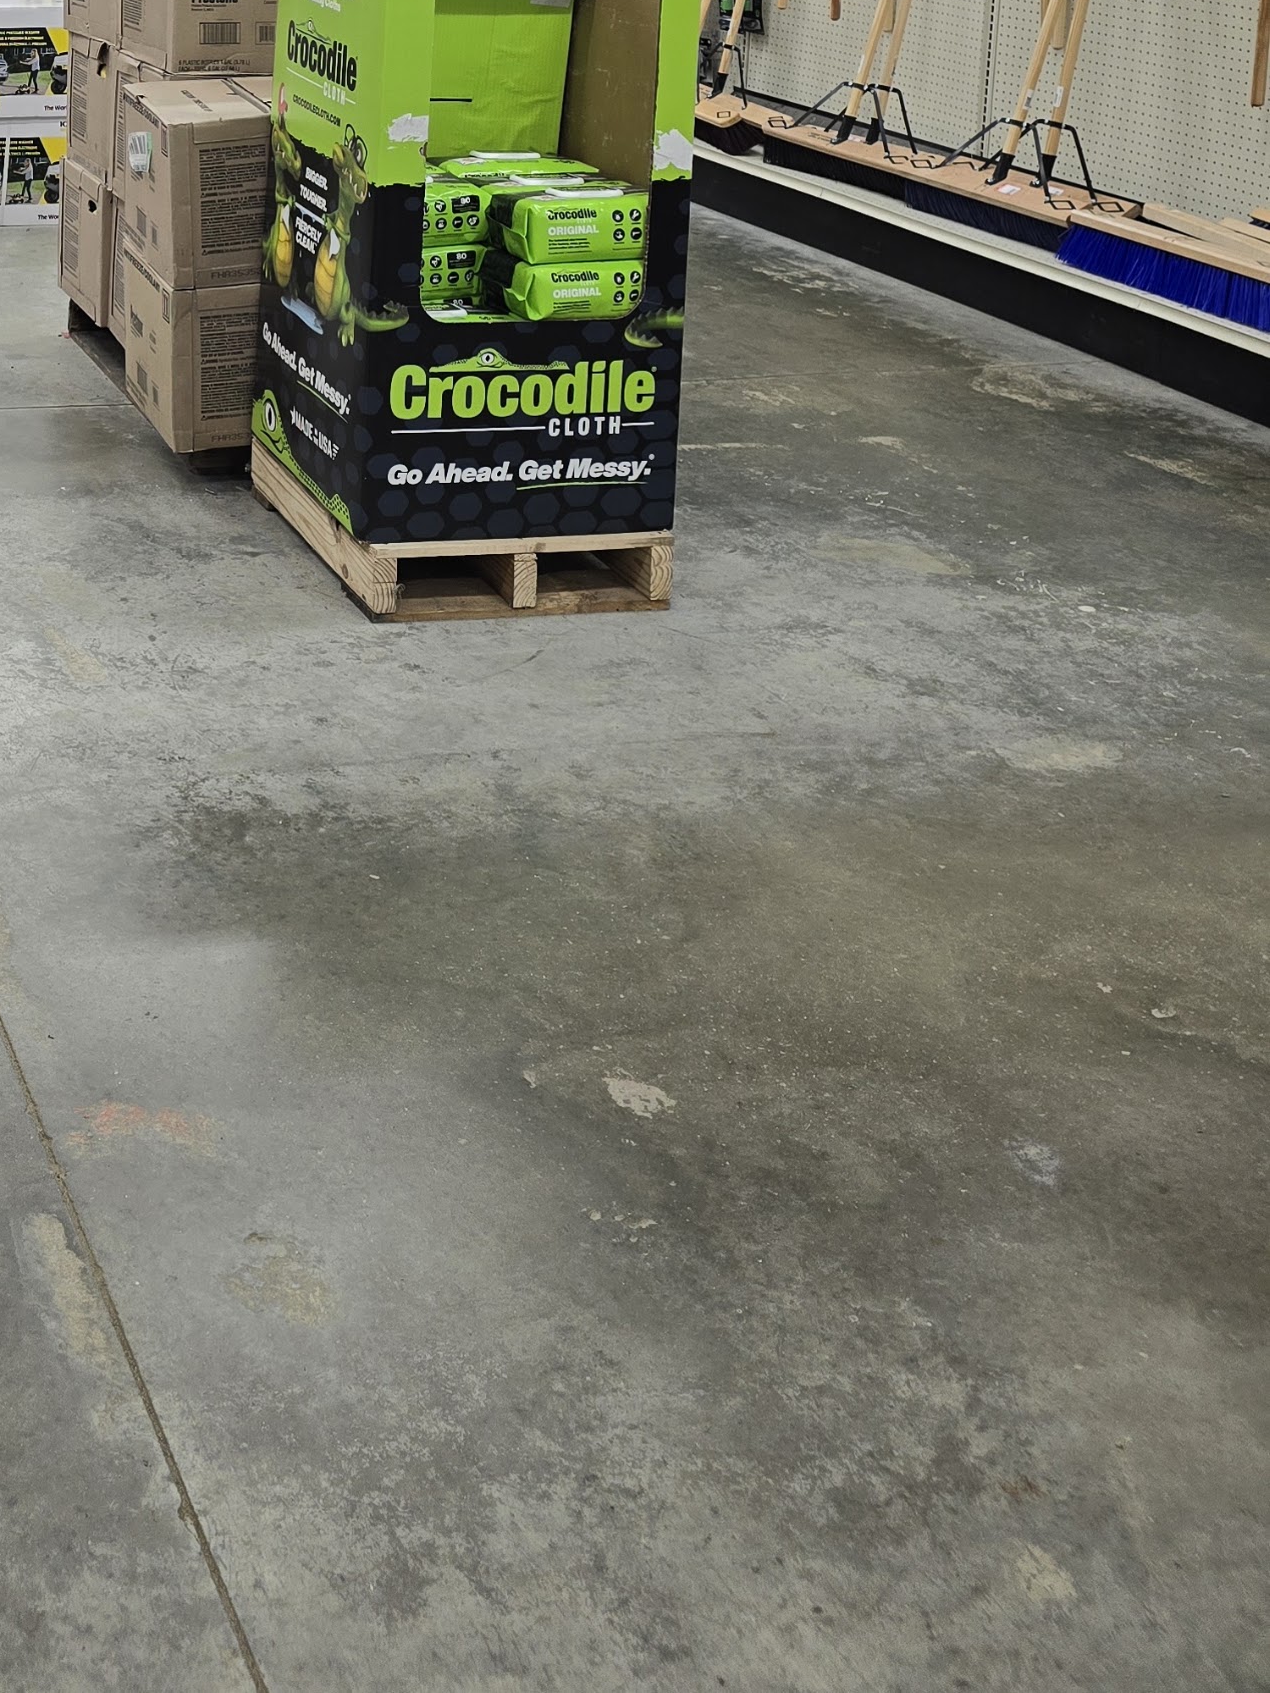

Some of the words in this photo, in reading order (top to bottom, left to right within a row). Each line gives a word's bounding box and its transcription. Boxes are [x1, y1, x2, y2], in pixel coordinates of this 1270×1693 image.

[287, 19, 358, 92] Crocodile
[323, 81, 346, 106] CLOTH
[305, 166, 328, 190] BIGGER.
[300, 184, 328, 212] TOUGHER.
[546, 208, 598, 221] Crocodile
[295, 215, 322, 242] FIERCELY
[547, 224, 599, 236] ORIGINAL
[456, 252, 467, 260] 80
[550, 271, 600, 283] Crocodile
[553, 287, 601, 299] ORIGINAL
[262, 321, 272, 346] Go
[271, 332, 297, 372] Ahead.
[298, 356, 315, 386] Get
[315, 370, 350, 415] Messy.
[390, 360, 656, 420] Crocodile
[295, 411, 314, 441] MADE
[318, 431, 333, 459] USA
[548, 416, 621, 437] CLOTH
[387, 463, 423, 486] Go
[425, 461, 514, 485] Ahead.
[518, 459, 564, 481] Get
[565, 458, 652, 481] Messy.
